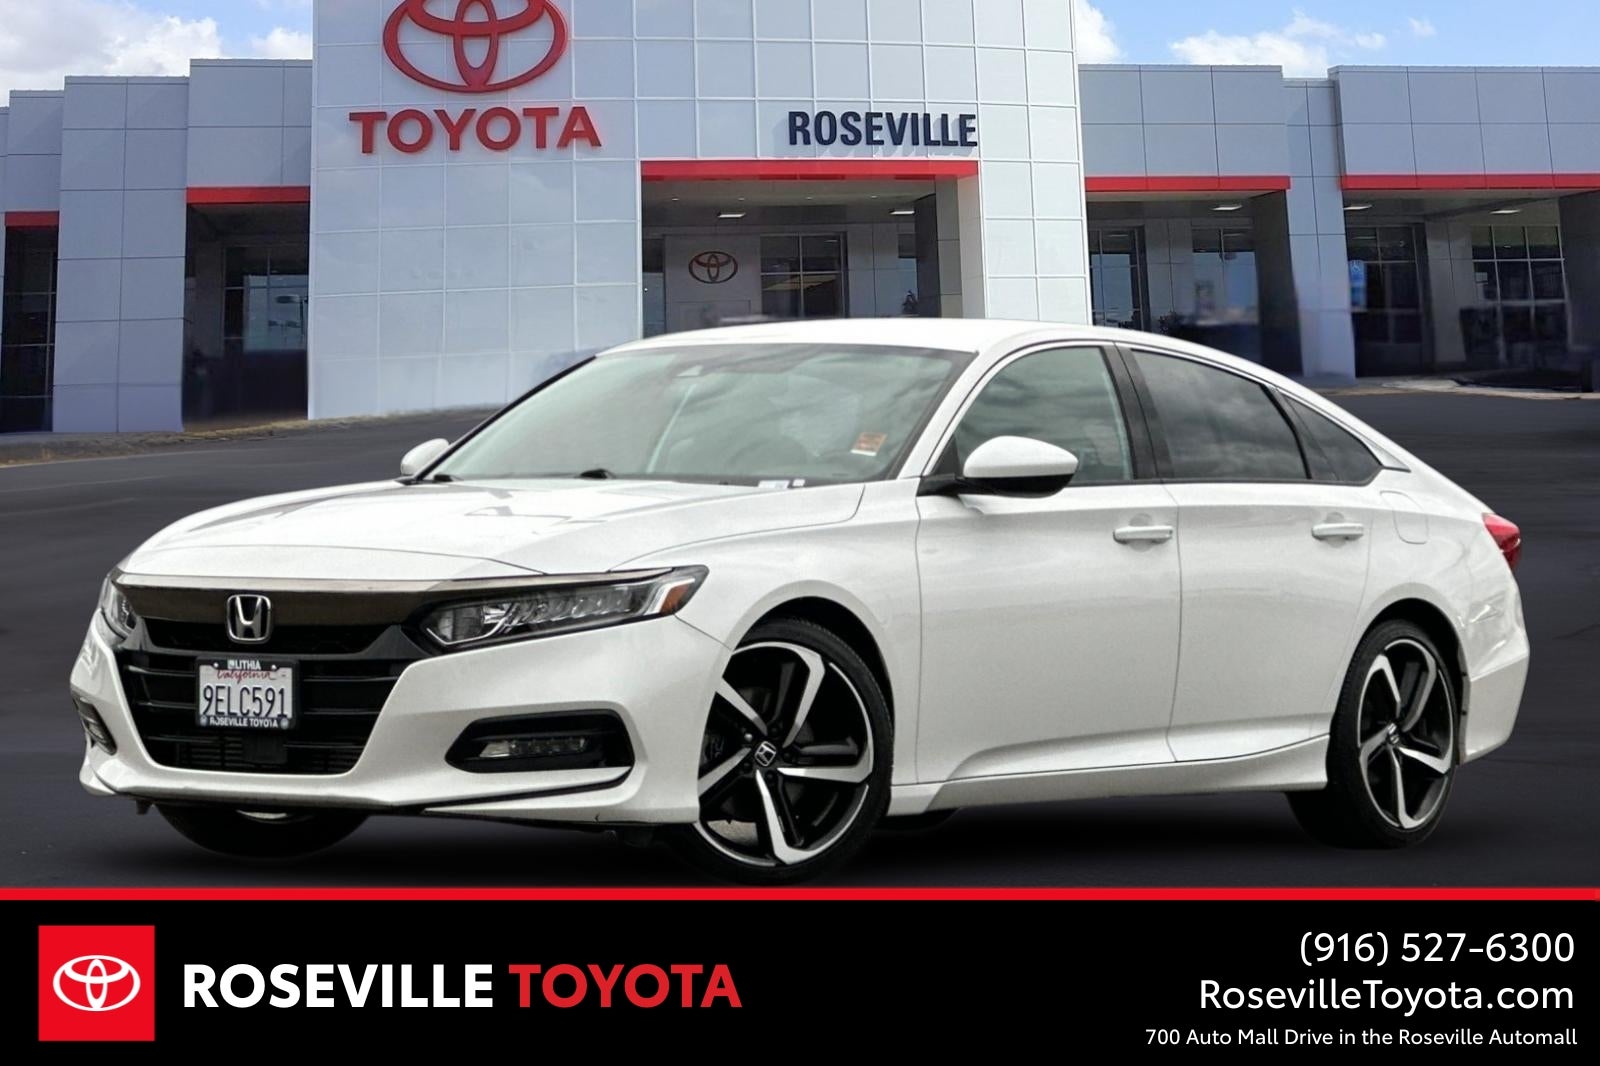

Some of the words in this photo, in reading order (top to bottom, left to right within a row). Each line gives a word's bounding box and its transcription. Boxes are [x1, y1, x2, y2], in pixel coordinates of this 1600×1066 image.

[349, 106, 602, 154] TOYOTA
[788, 110, 979, 148] ROSEVILLE
[216, 669, 275, 684] California
[236, 659, 261, 671] LITHIA
[203, 685, 288, 718] 9ELC591
[250, 718, 278, 728] TOYOTA
